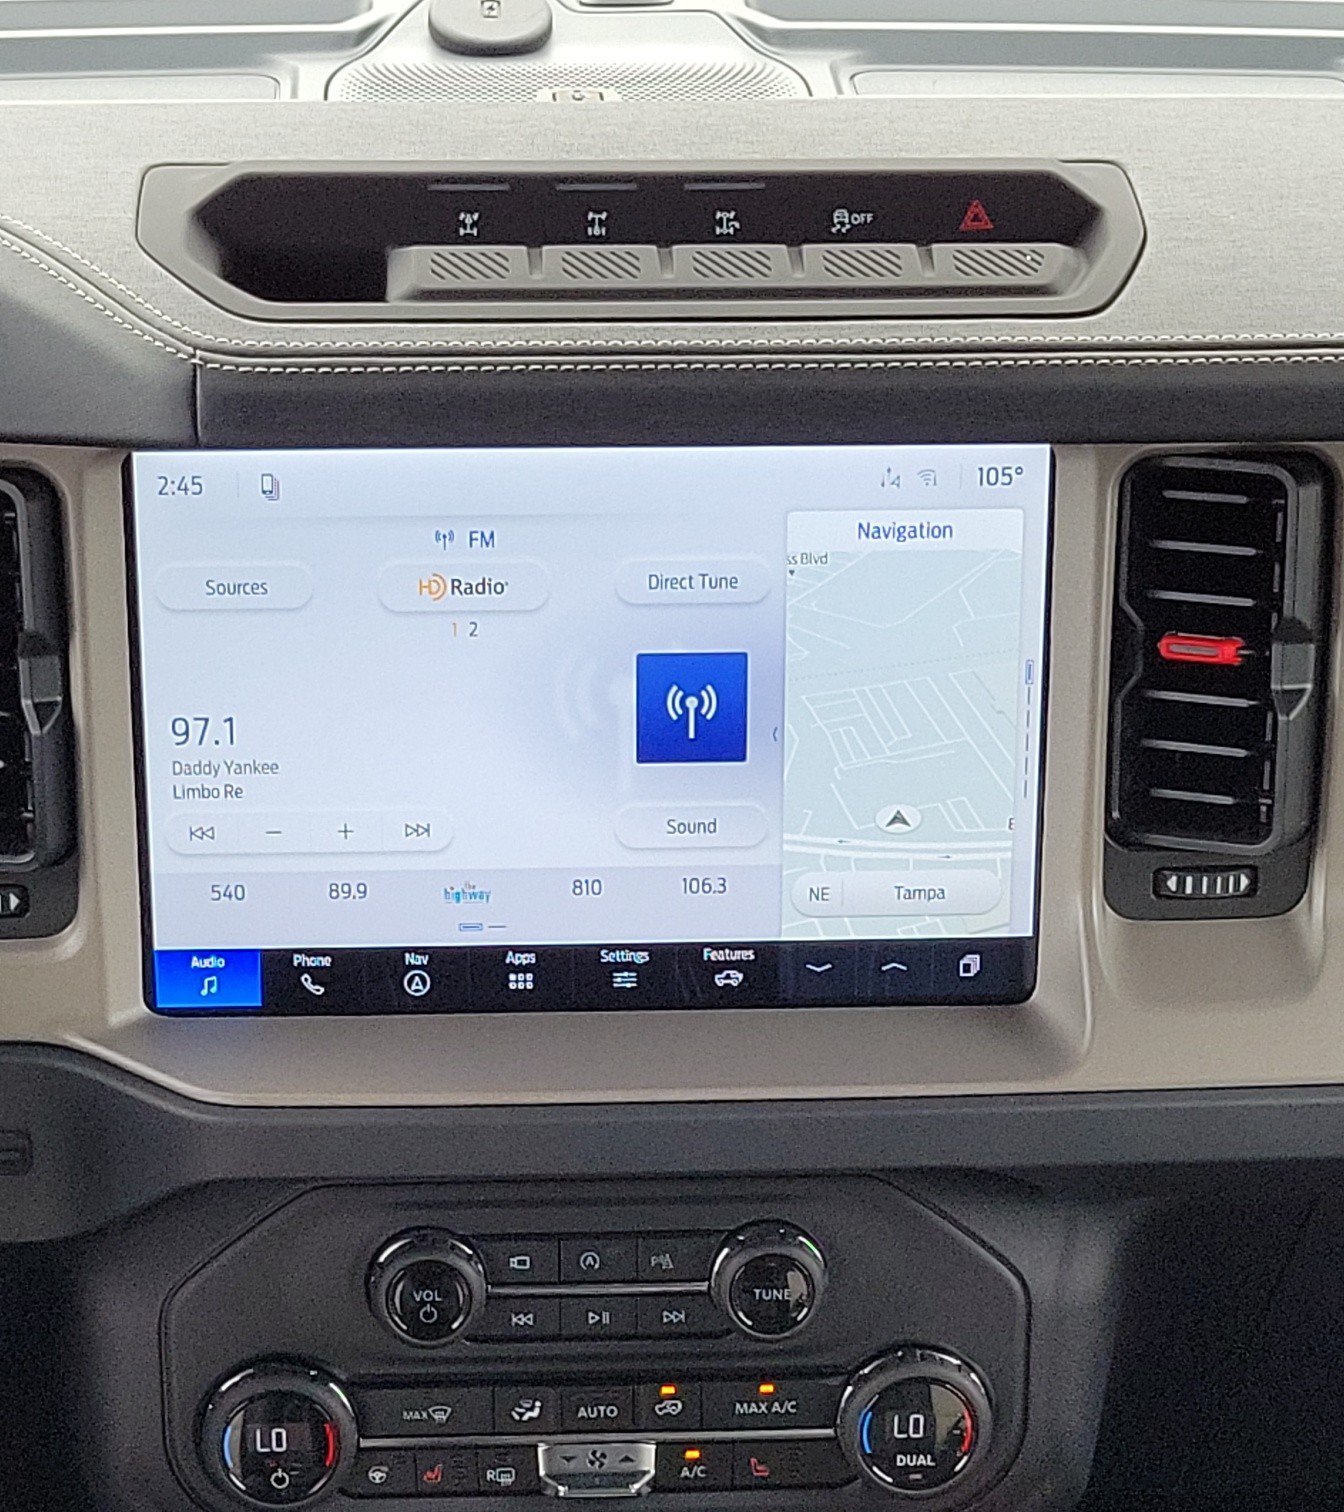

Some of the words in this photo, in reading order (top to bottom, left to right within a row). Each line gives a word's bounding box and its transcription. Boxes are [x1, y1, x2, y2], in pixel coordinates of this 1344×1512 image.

[850, 212, 874, 225] OFF
[977, 465, 1024, 487] 105°
[157, 475, 204, 497] 2:45
[468, 530, 496, 549] FM
[856, 521, 954, 543] Navigation
[800, 551, 828, 565] Blvd
[204, 578, 269, 597] Sources
[450, 577, 506, 597] Radio
[648, 572, 694, 590] Direct
[699, 572, 739, 590] Tune
[451, 621, 458, 638] 1
[468, 621, 479, 638] 2
[170, 716, 237, 747] 97.1
[171, 759, 221, 778] Daddy
[224, 759, 280, 776] Yankee
[172, 783, 221, 800] Limbo
[223, 784, 244, 800] Re
[666, 817, 718, 836] Sound
[210, 884, 246, 902] 540
[327, 881, 368, 900] 89.9
[571, 878, 603, 896] 810
[681, 876, 727, 896] 106.3
[808, 886, 831, 902] NE
[894, 886, 946, 903] Tampa
[190, 954, 226, 969] Audio
[292, 953, 333, 968] Phone
[404, 952, 429, 967] Nav
[505, 950, 536, 967] Apps
[599, 948, 650, 965] Settings
[702, 947, 756, 962] Features
[412, 1289, 443, 1302] VOL
[753, 1288, 792, 1300] TUNE
[577, 1405, 619, 1418] AUTO
[735, 1401, 770, 1415] MAX
[771, 1400, 797, 1414] A/C
[893, 1413, 925, 1439] LO
[256, 1427, 287, 1453] LO
[895, 1454, 936, 1467] DUAL
[680, 1465, 707, 1478] A/C
